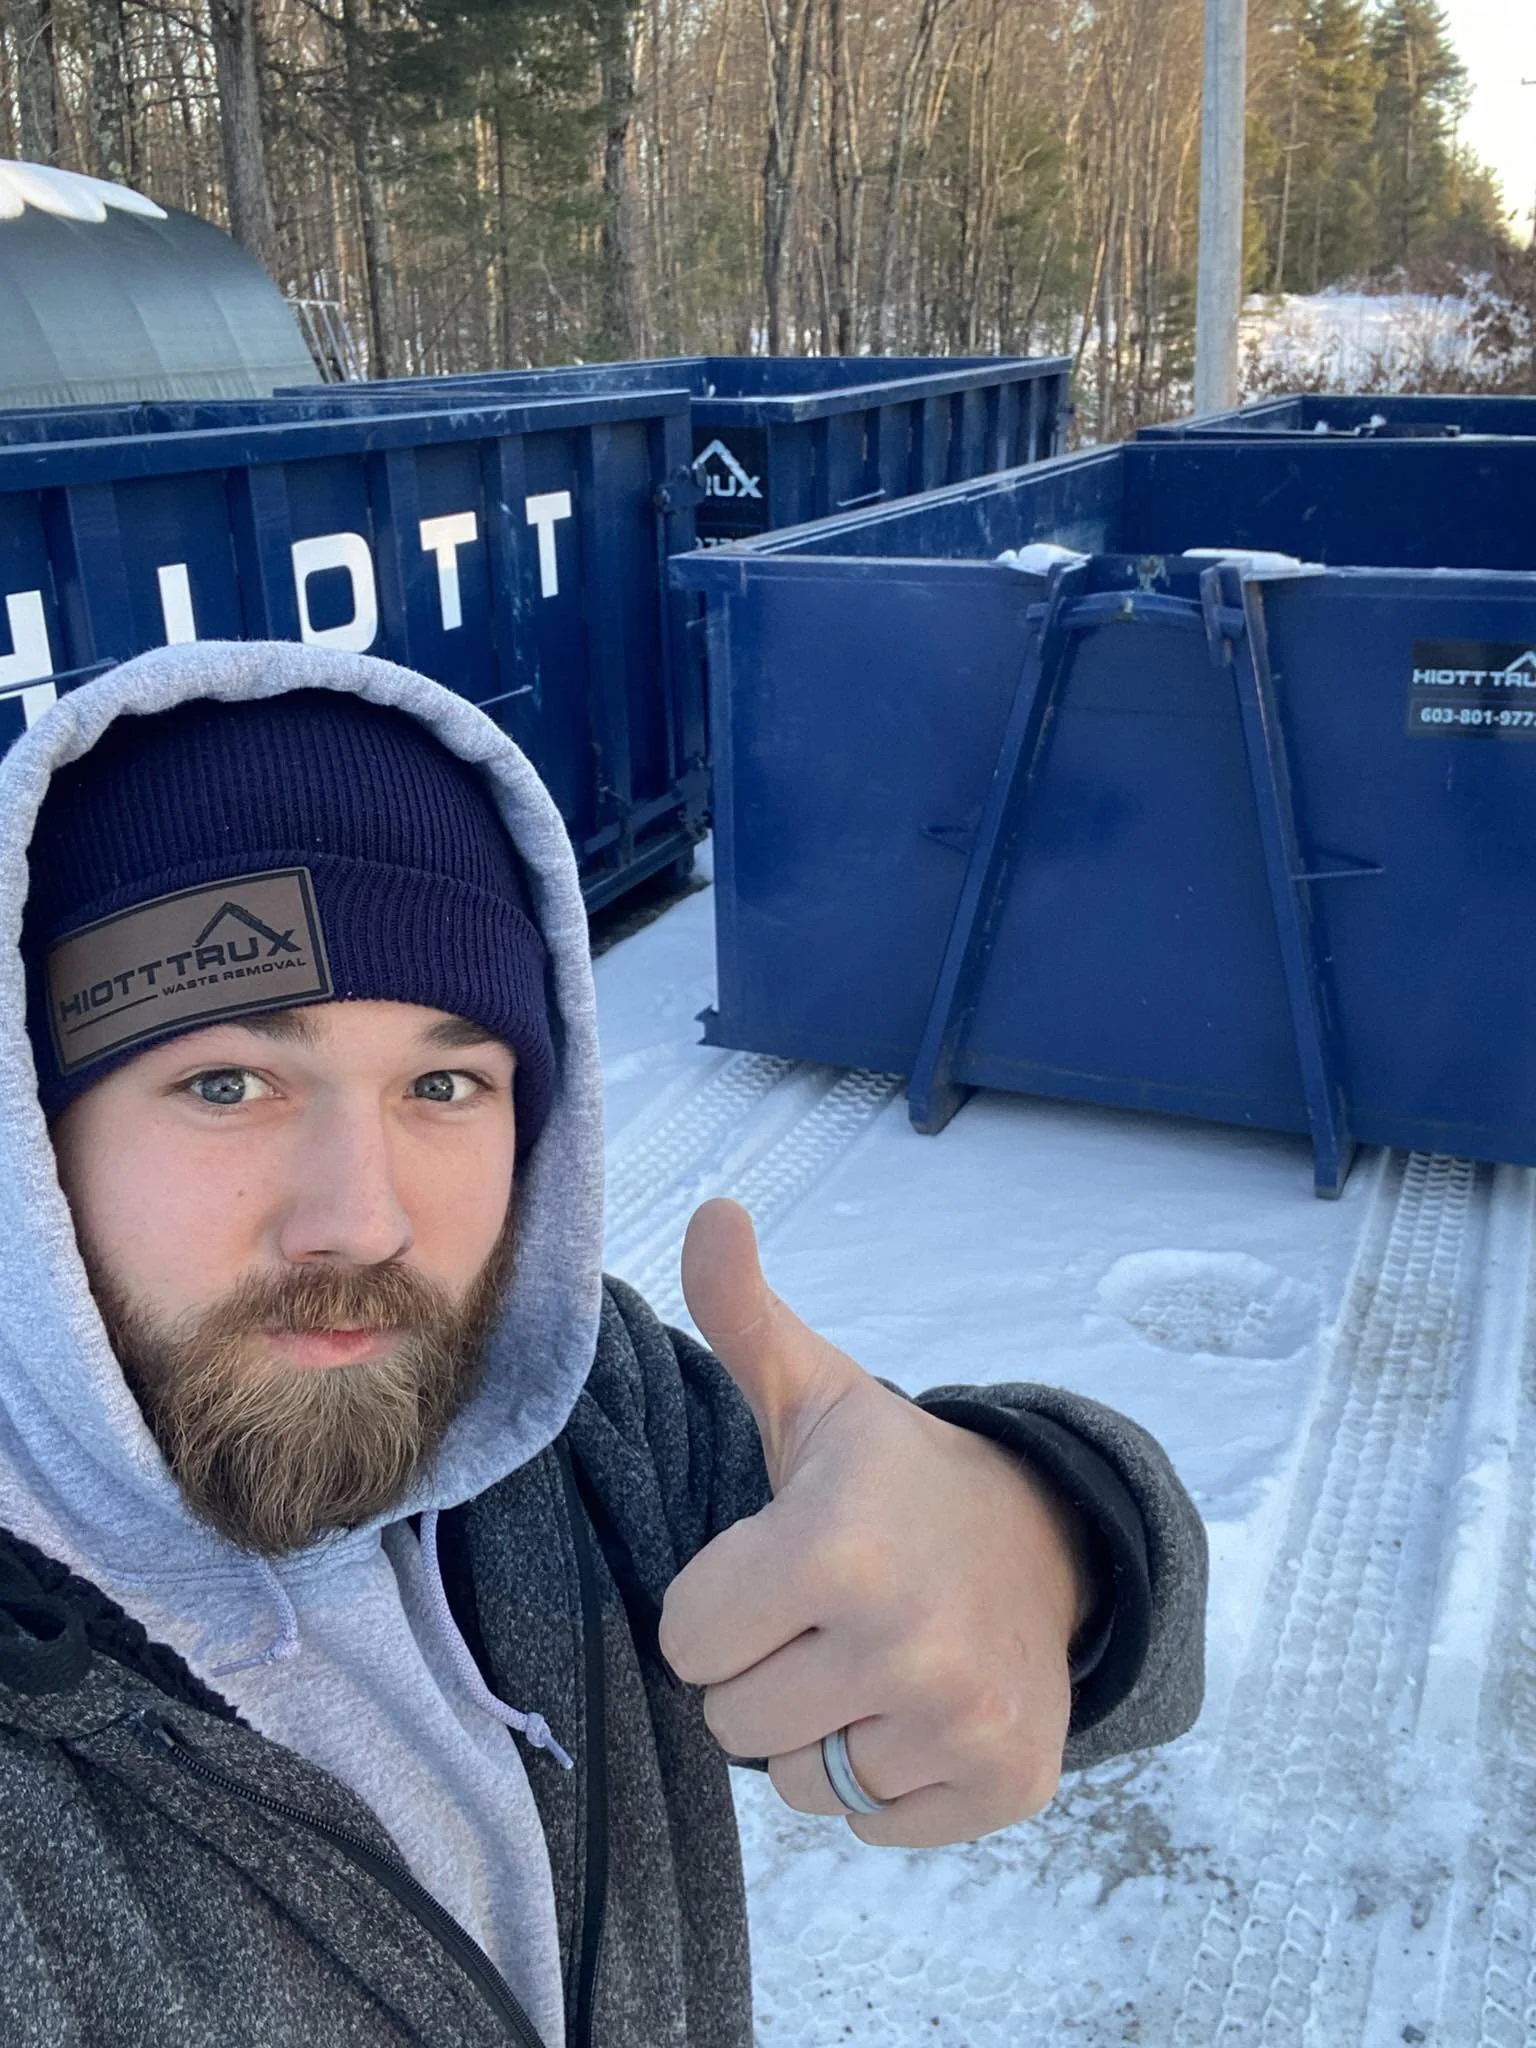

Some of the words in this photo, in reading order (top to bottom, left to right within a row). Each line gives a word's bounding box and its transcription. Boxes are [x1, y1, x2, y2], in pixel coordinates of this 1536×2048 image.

[1420, 707, 1536, 726] 603-801-977
[161, 974, 219, 996] WASTE
[223, 957, 307, 981] REMOVAL
